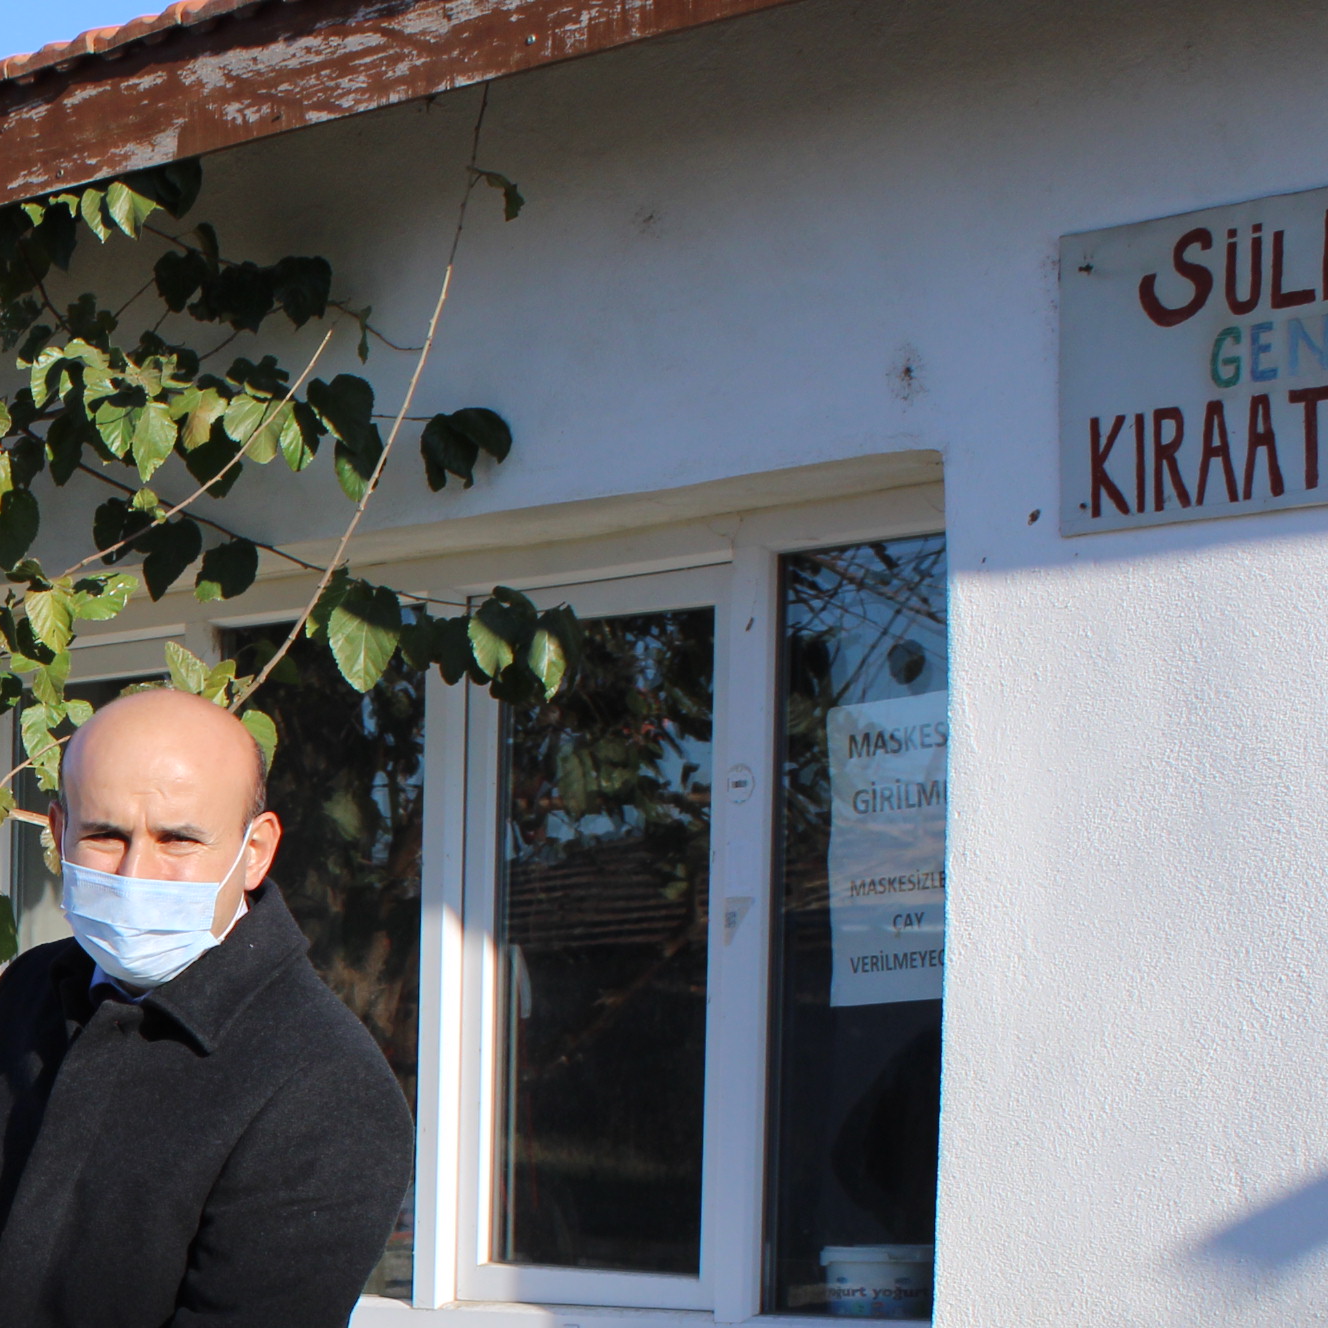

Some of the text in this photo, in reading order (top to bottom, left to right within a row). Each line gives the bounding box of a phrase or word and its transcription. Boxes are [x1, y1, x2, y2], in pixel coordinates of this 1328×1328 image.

[1139, 209, 1328, 327] SÜL
[1090, 386, 1328, 518] KIRAAT
[852, 778, 947, 815] GİRİLM
